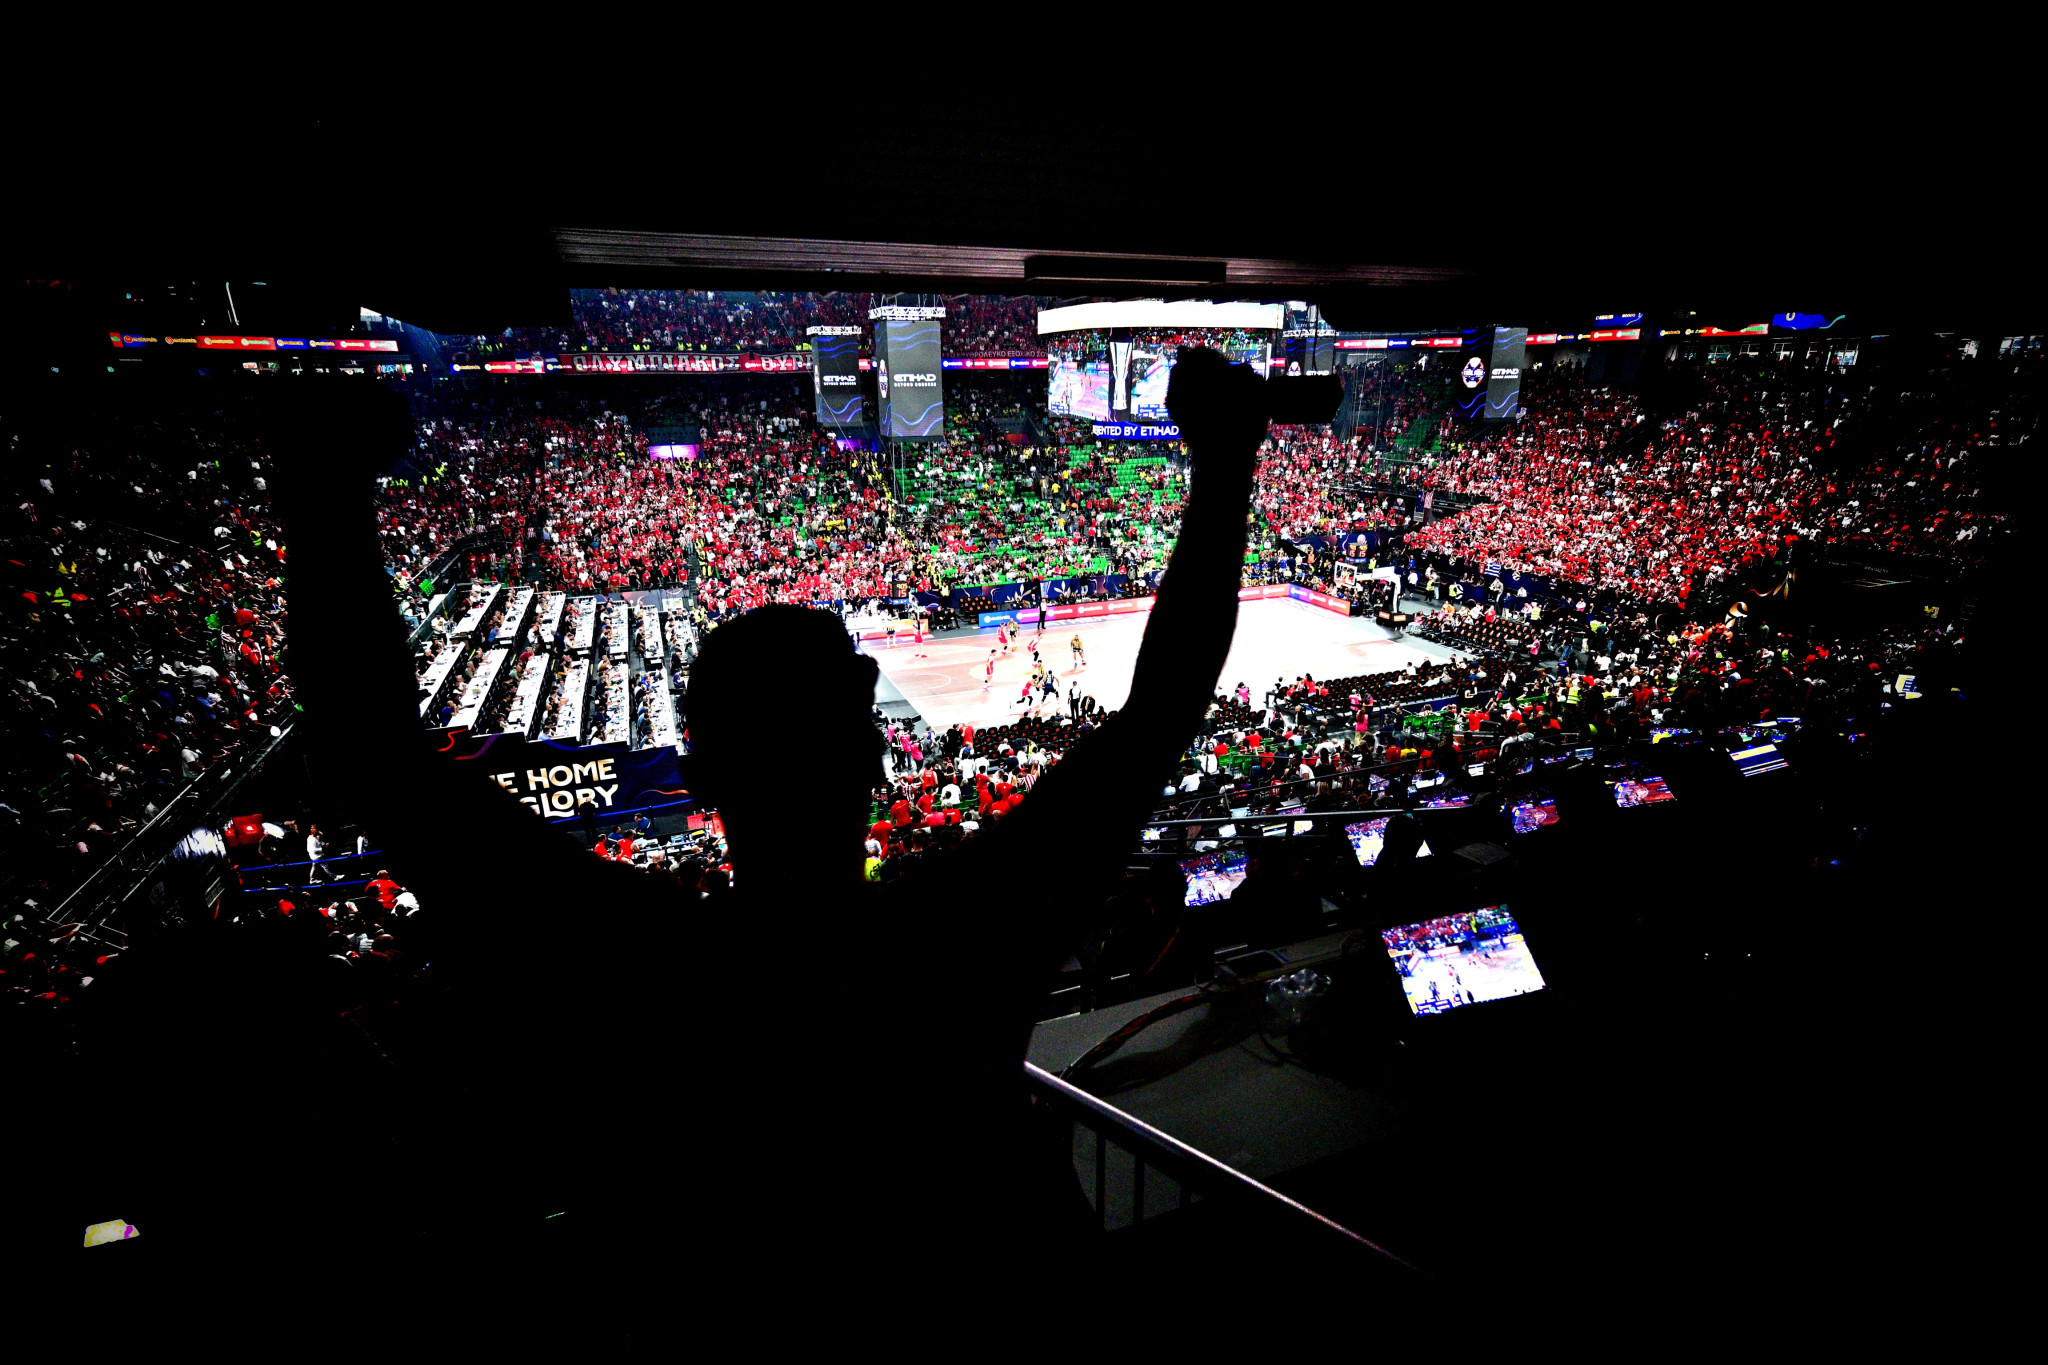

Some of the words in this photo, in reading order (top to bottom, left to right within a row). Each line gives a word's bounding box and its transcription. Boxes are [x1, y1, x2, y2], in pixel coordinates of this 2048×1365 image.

[572, 354, 740, 372] ΟΛΥΜΠΙΑΚΟΣ
[893, 373, 937, 382] ETIHAD
[1124, 427, 1138, 436] BY
[1140, 426, 1179, 436] ETIHAD
[898, 589, 907, 598] 15
[526, 758, 617, 791] HOME
[519, 783, 619, 818] GLORY
